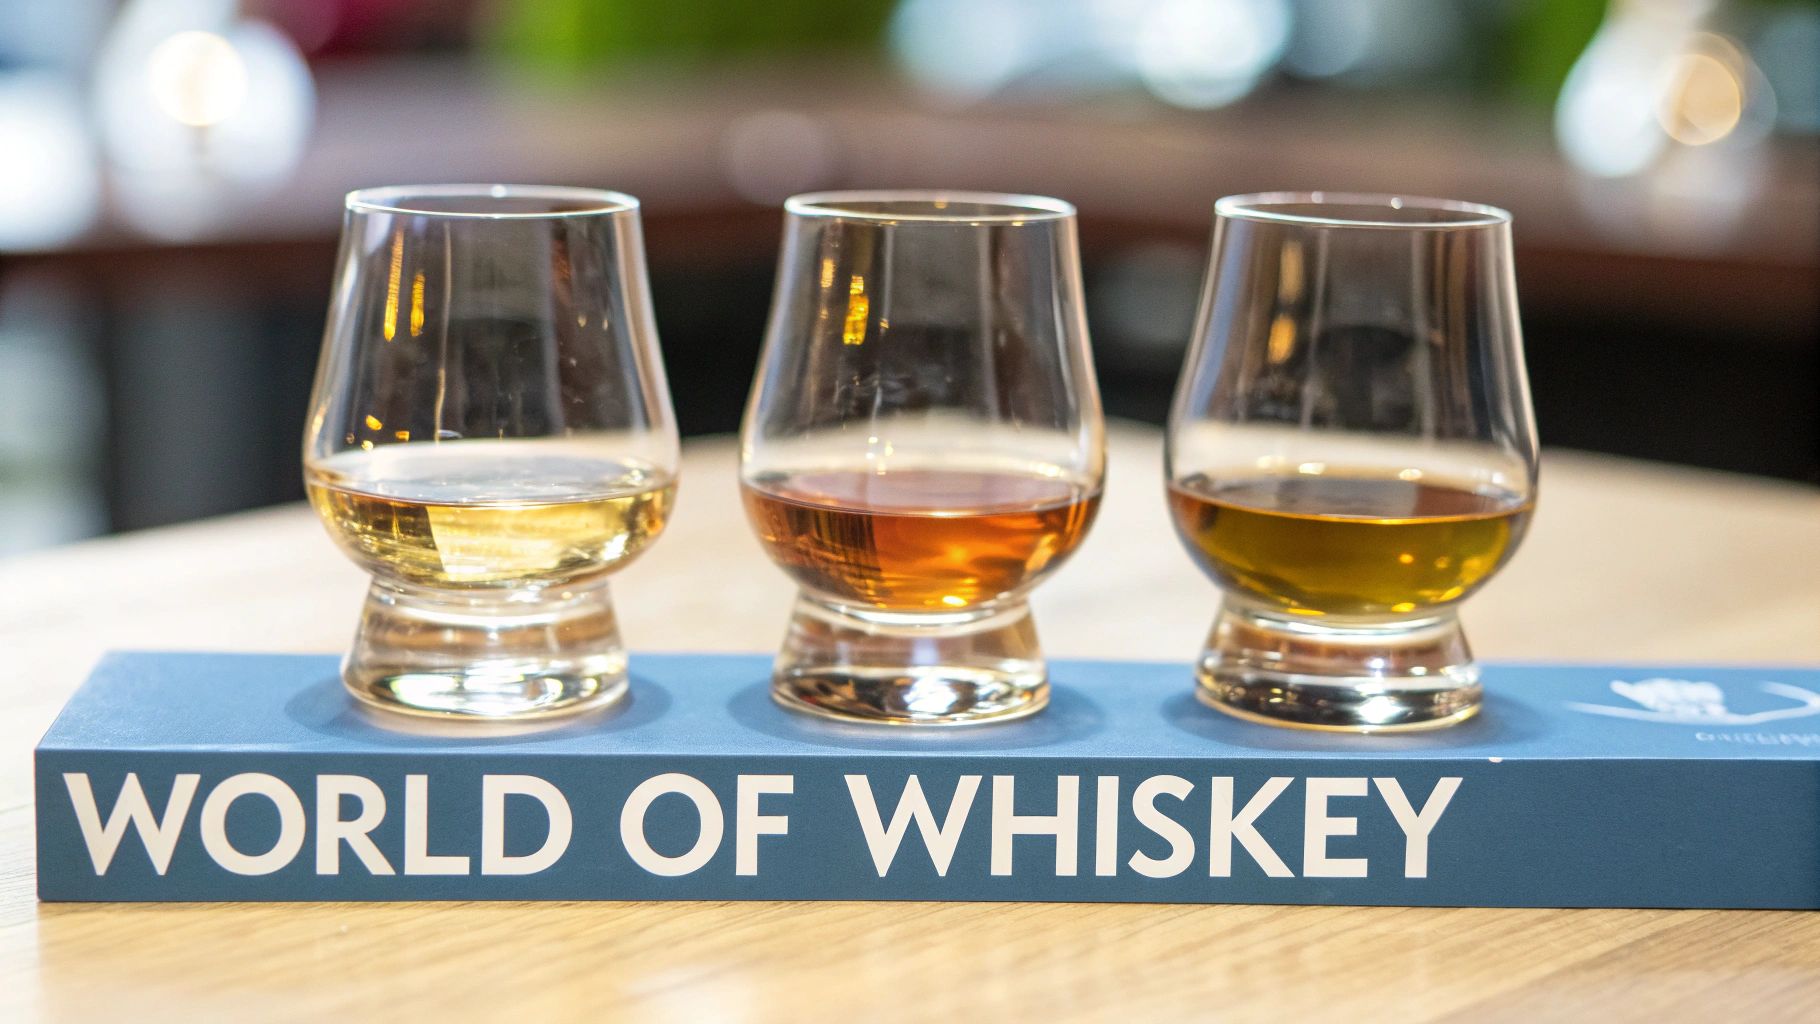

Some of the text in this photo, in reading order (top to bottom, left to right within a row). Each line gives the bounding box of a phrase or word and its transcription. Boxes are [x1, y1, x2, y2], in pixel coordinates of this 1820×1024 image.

[64, 772, 1464, 879] WORLD OF WHISKEY
